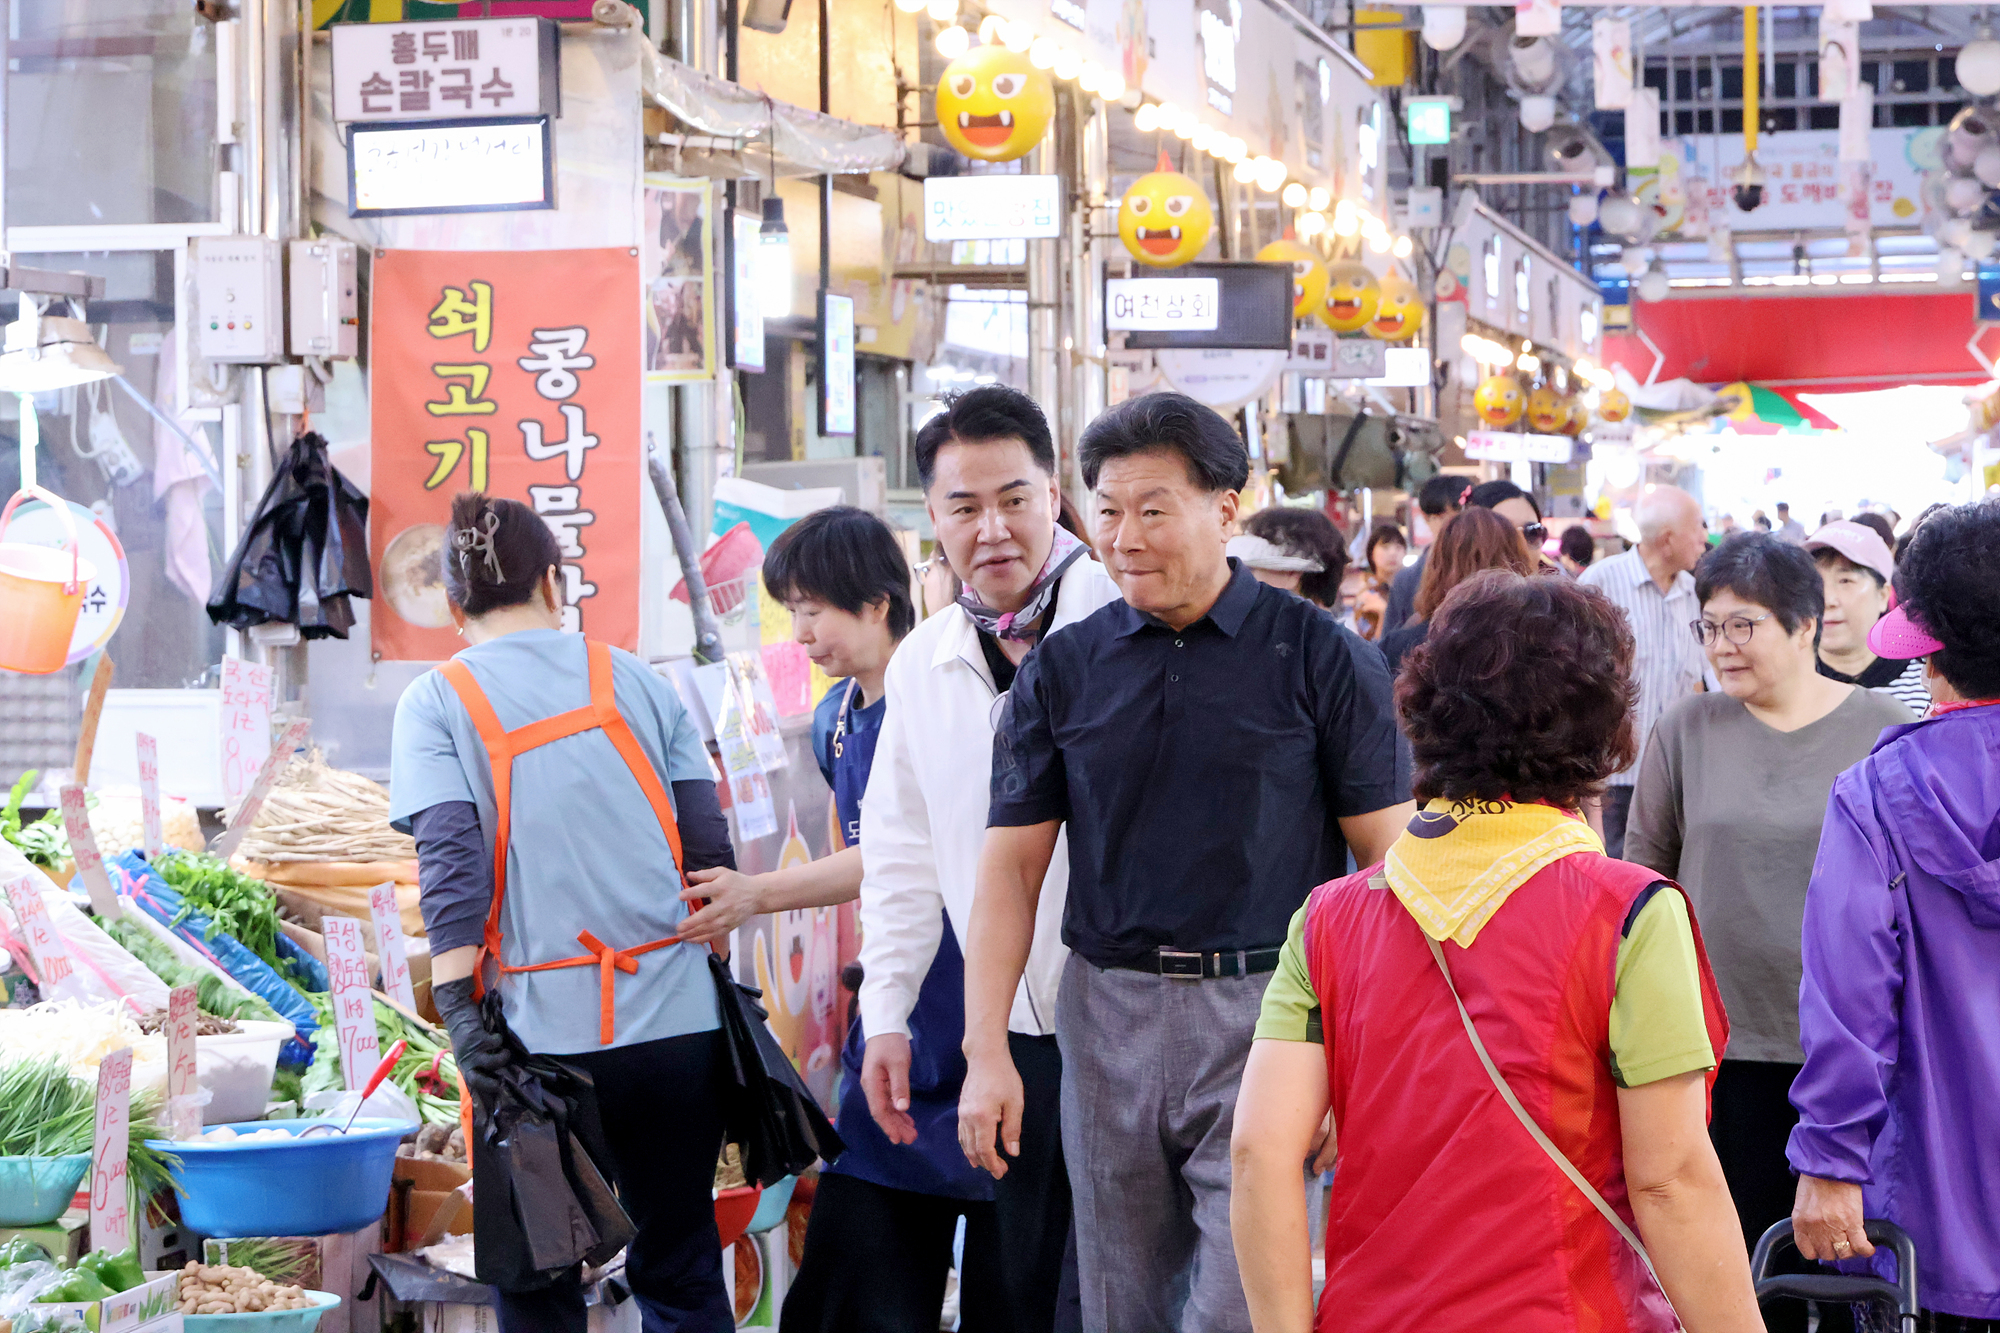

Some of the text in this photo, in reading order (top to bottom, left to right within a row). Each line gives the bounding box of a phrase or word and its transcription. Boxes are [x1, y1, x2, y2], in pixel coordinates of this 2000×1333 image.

[392, 29, 479, 64] 홍두깨
[360, 67, 514, 113] 손칼국수
[1114, 294, 1211, 319] 여천상회
[424, 279, 497, 493] 쇠고기
[225, 660, 268, 688] 국산
[223, 685, 271, 718] 도라지
[326, 921, 356, 951] 곡성
